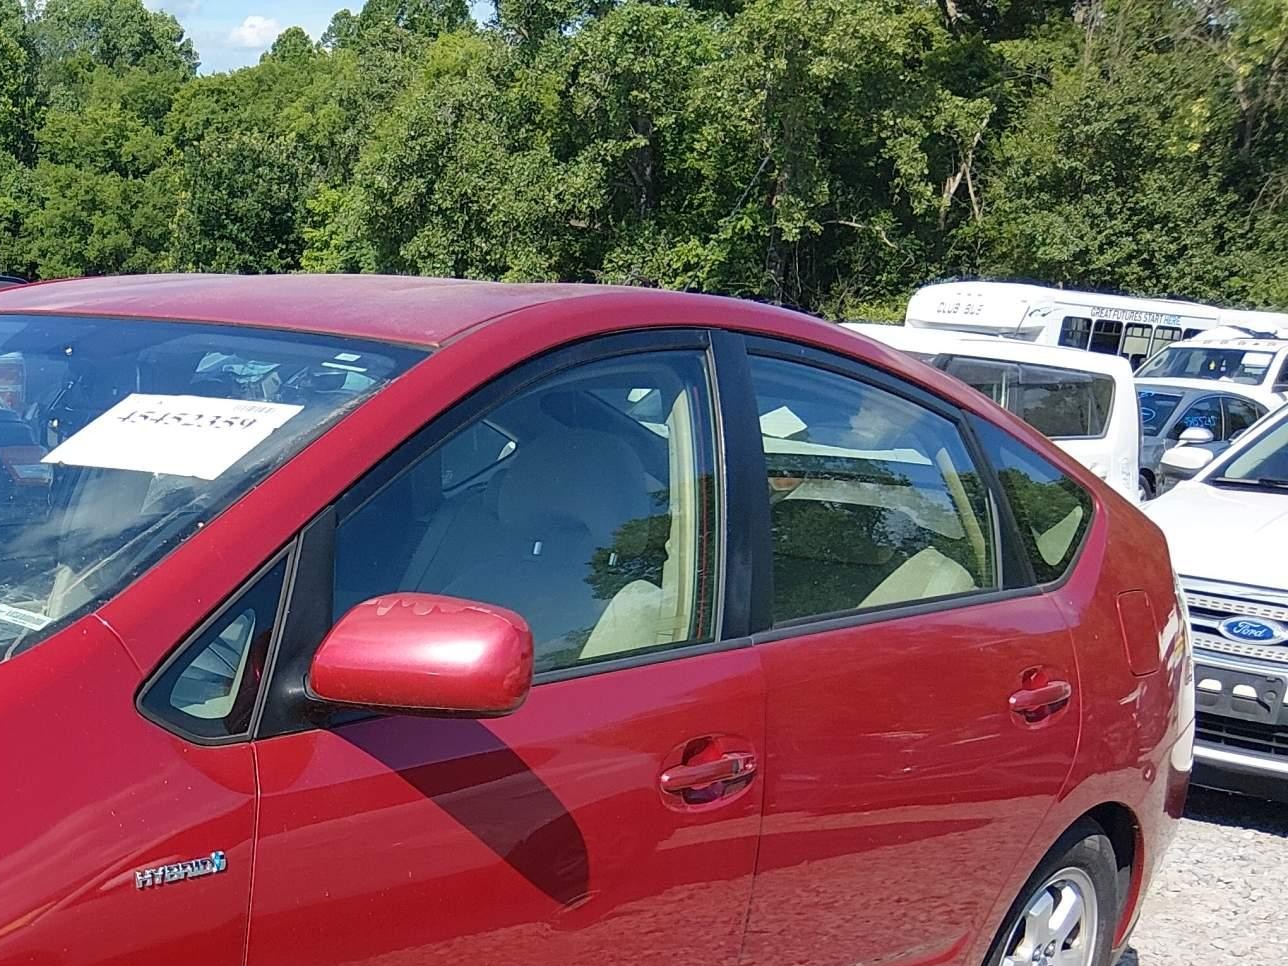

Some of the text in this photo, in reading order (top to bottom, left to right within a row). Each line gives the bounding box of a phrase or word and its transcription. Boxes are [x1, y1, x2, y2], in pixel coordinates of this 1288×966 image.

[1090, 307, 1181, 326] GREAT FUTURES START HERE
[1233, 621, 1267, 638] Ford
[135, 859, 213, 889] HYBRID
